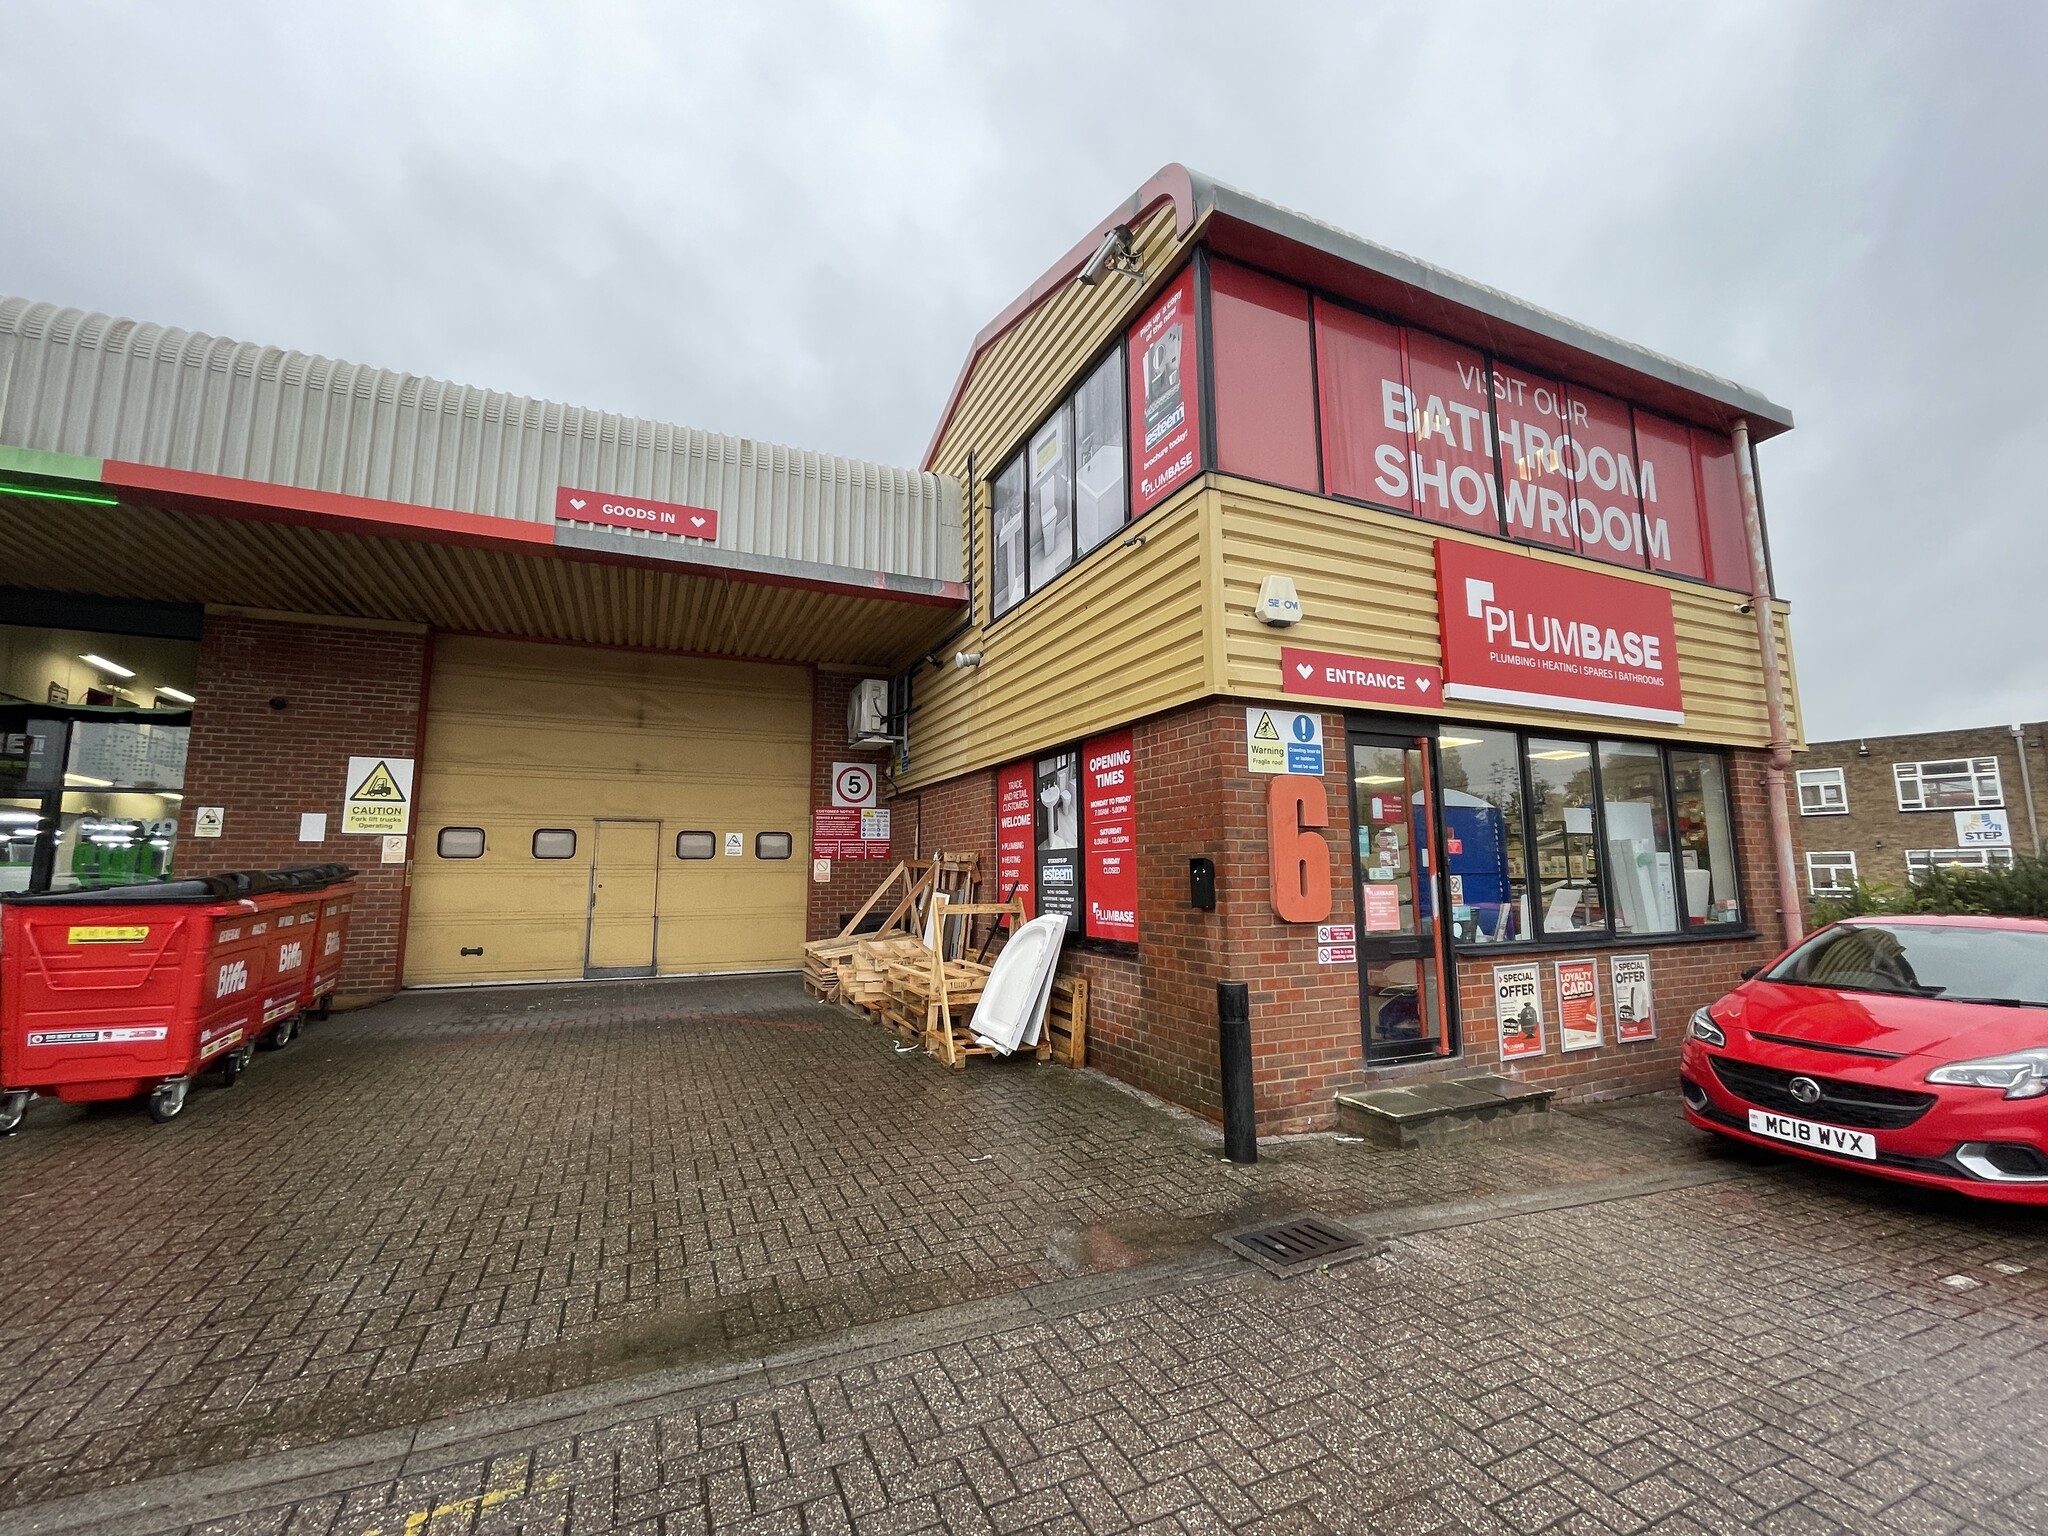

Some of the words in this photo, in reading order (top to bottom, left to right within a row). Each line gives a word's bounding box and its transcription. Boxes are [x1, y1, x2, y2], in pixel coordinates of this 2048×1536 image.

[1456, 361, 1527, 407] VISIT
[1534, 388, 1589, 428] OUR
[1145, 404, 1184, 446] esteem
[1381, 378, 1657, 503] BATHROOM
[1143, 445, 1169, 470] brochure
[1145, 451, 1193, 497] PLUMBASE
[1374, 444, 1671, 561] SHOWROOM
[602, 503, 656, 521] GOODS
[660, 511, 675, 524] IN
[1268, 598, 1298, 610] SEOM
[1485, 605, 1662, 670] PLUMBASE
[1490, 652, 1536, 668] PLUMBING
[1542, 659, 1578, 674] HEATING
[1584, 665, 1613, 679] SPARES
[1618, 671, 1664, 687] BATHROOMS
[1326, 667, 1405, 690] ENTRANCE
[1251, 745, 1284, 758] Warning
[1089, 749, 1131, 772] OPENING
[1252, 758, 1270, 766] Fragile
[847, 775, 862, 795] 5
[1007, 779, 1022, 790] TRADE
[1095, 769, 1124, 788] TIMES
[1003, 793, 1013, 801] AND
[1013, 789, 1028, 801] RETAIL
[1090, 798, 1108, 808] MONDAY
[1115, 795, 1131, 804] FRIDAY
[352, 806, 402, 815] CAUTION
[1002, 799, 1029, 812] CUSTOMERS
[1001, 813, 1031, 828] WELCOME
[1099, 827, 1122, 836] SATURDAY
[1965, 831, 2003, 840] STEP
[1268, 775, 1332, 922] 6
[1102, 857, 1120, 865] SUNDAY
[1044, 867, 1073, 881] esteem
[1103, 866, 1120, 874] CLOSED
[1095, 909, 1134, 923] PLUMBASE
[324, 930, 341, 956] Biffa
[278, 941, 303, 973] Biffa
[1618, 961, 1644, 971] SPECIAL
[216, 960, 248, 999] Biffa
[1503, 972, 1533, 983] SPECIAL
[1560, 971, 1592, 982] LOYALTY
[1615, 971, 1645, 984] OFFER
[1500, 983, 1535, 998] OFFER
[1561, 980, 1593, 996] CARD
[1765, 1115, 1811, 1141] MC18
[1818, 1126, 1864, 1153] WVX
